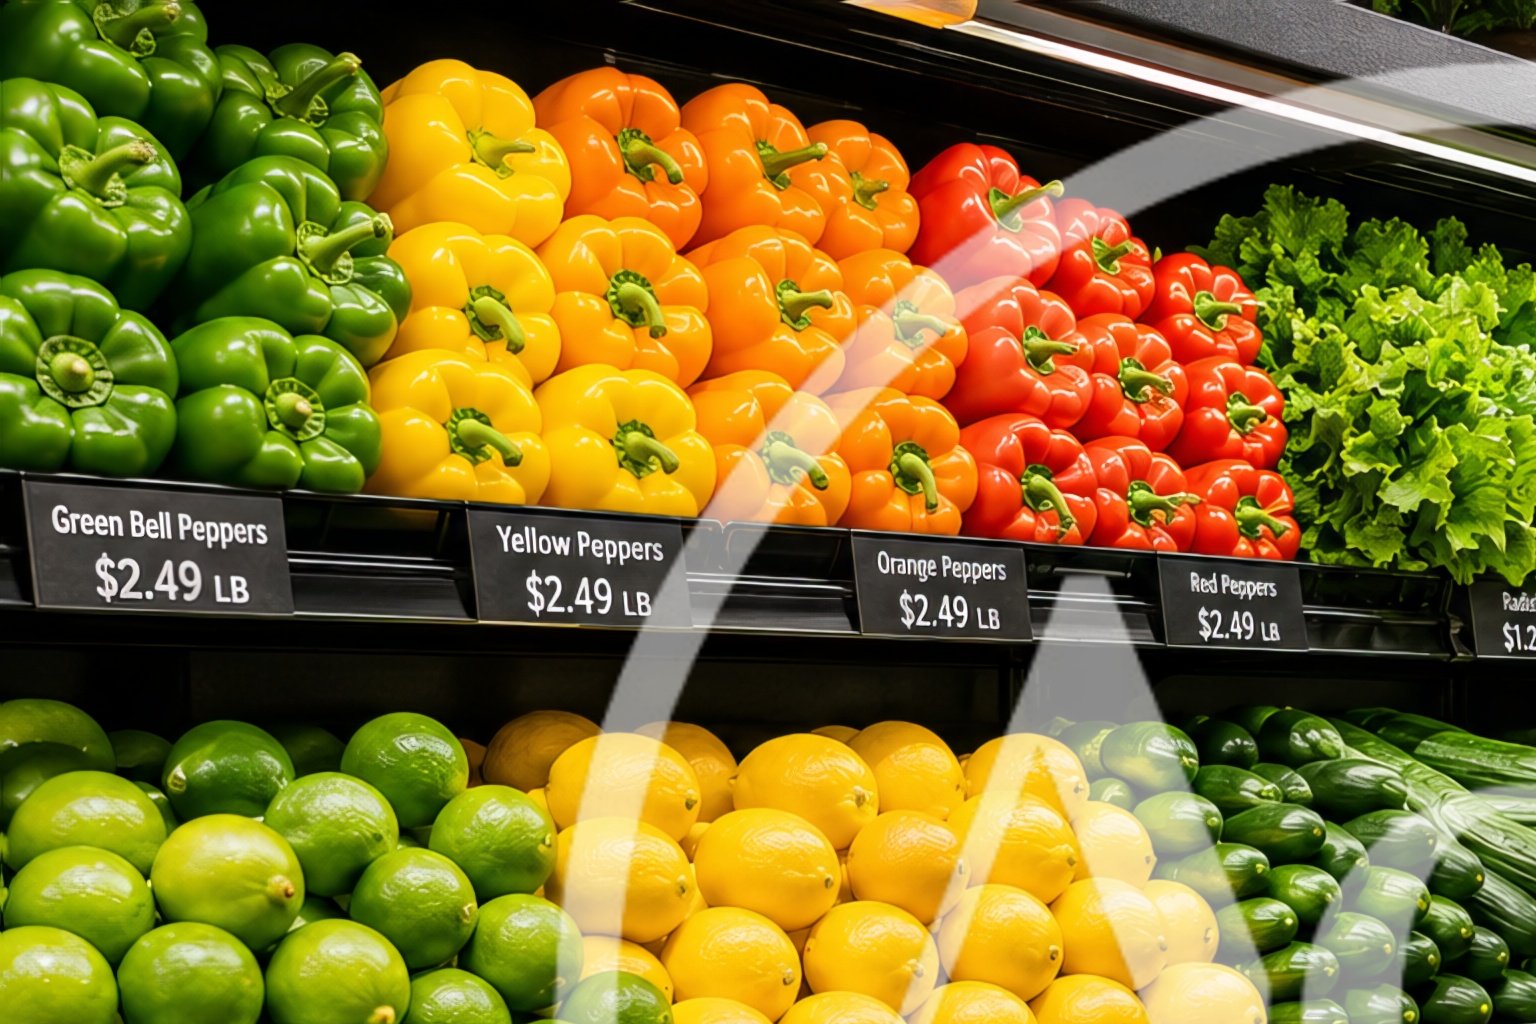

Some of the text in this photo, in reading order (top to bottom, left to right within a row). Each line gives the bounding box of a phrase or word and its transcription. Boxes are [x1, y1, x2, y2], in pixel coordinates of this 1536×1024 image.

[51, 504, 268, 549] Green Bell Peppers
[496, 524, 664, 566] Yellow Peppers
[95, 552, 250, 603] $2.49 LB
[877, 550, 1007, 584] Orange Peppers
[1190, 571, 1278, 600] Red Peppers
[526, 569, 652, 617] $2.49 LB
[900, 589, 1001, 630] $2.49 LB
[1198, 606, 1281, 642] $2.49 LB
